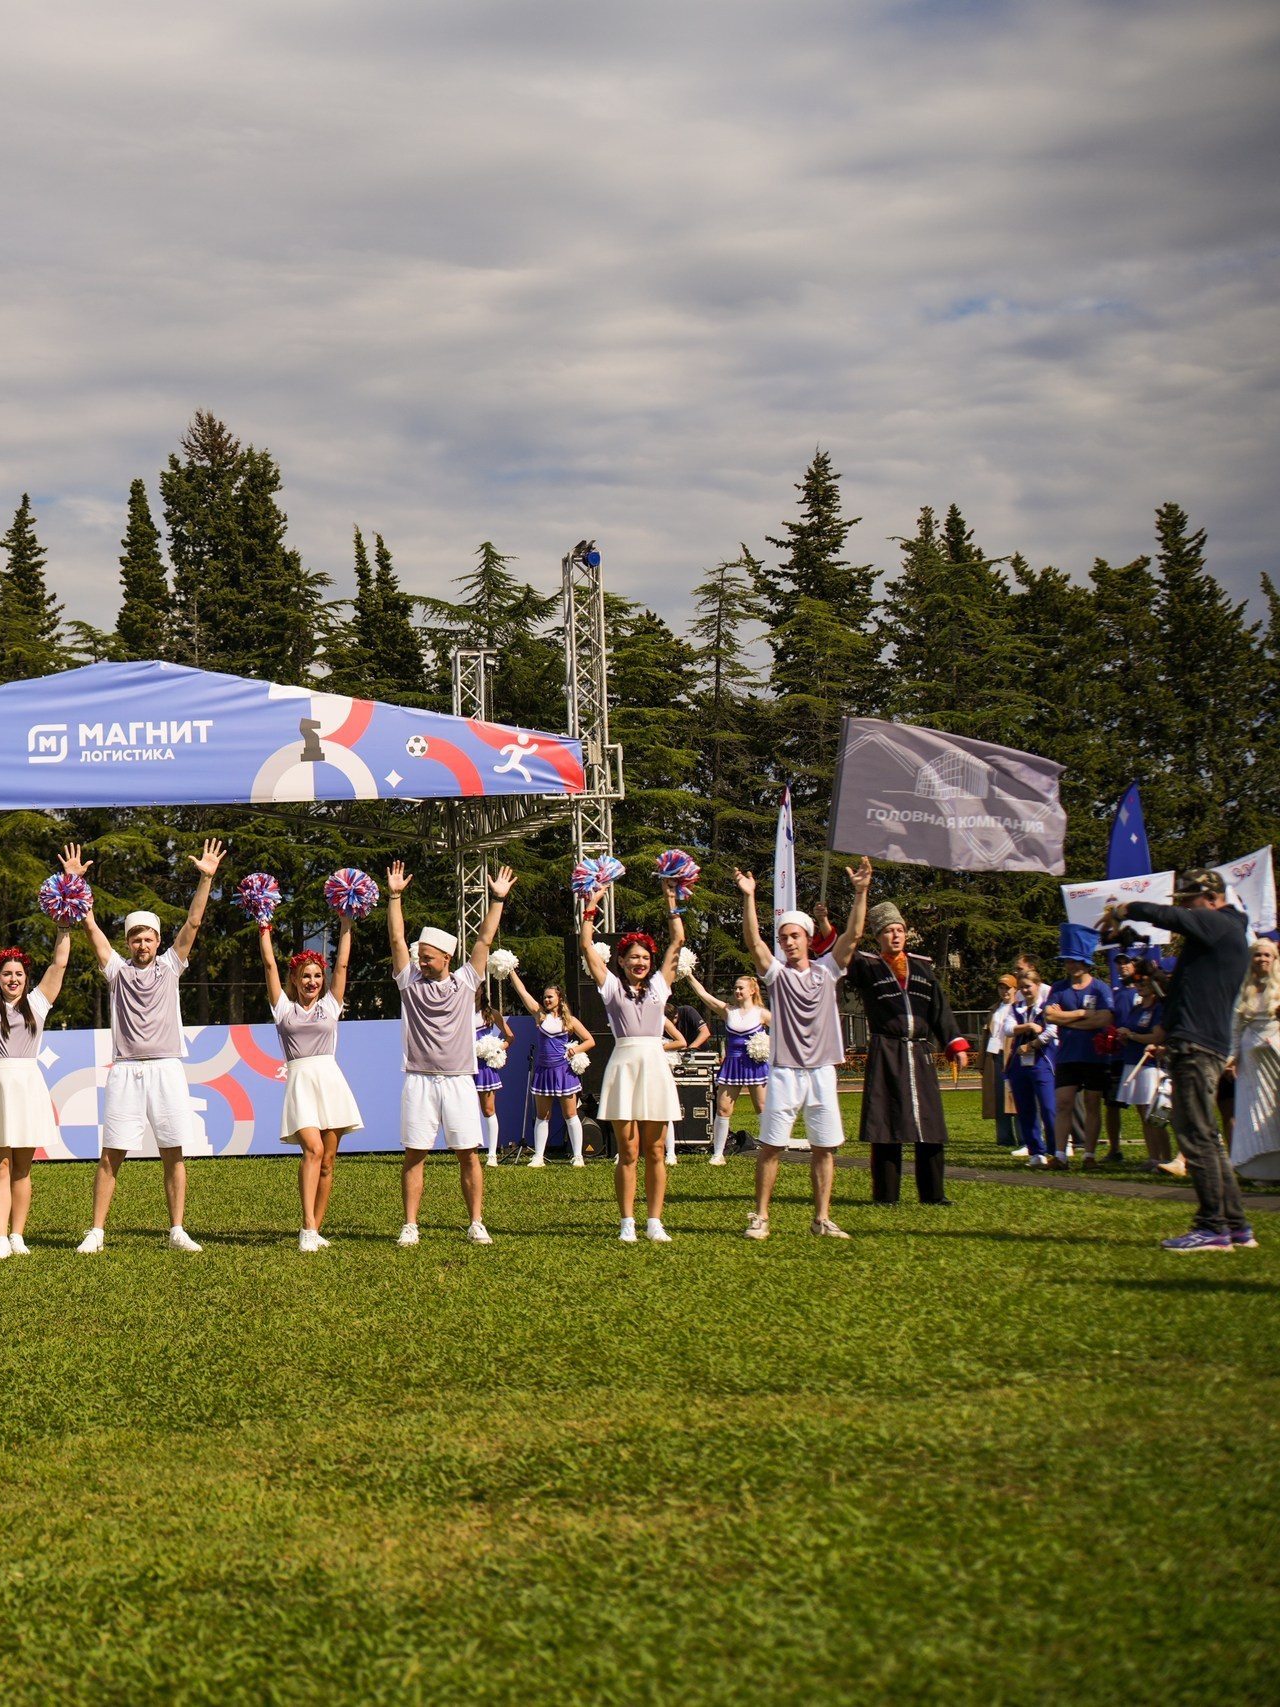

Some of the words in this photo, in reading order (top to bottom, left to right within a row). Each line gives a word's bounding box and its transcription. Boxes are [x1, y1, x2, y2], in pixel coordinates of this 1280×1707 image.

[78, 719, 214, 747] МАГНИТ
[80, 748, 176, 763] ЛОГИСТИКА
[866, 808, 956, 830] ГОЛОВНАЯ
[958, 815, 1045, 833] КОМПАНИЯ
